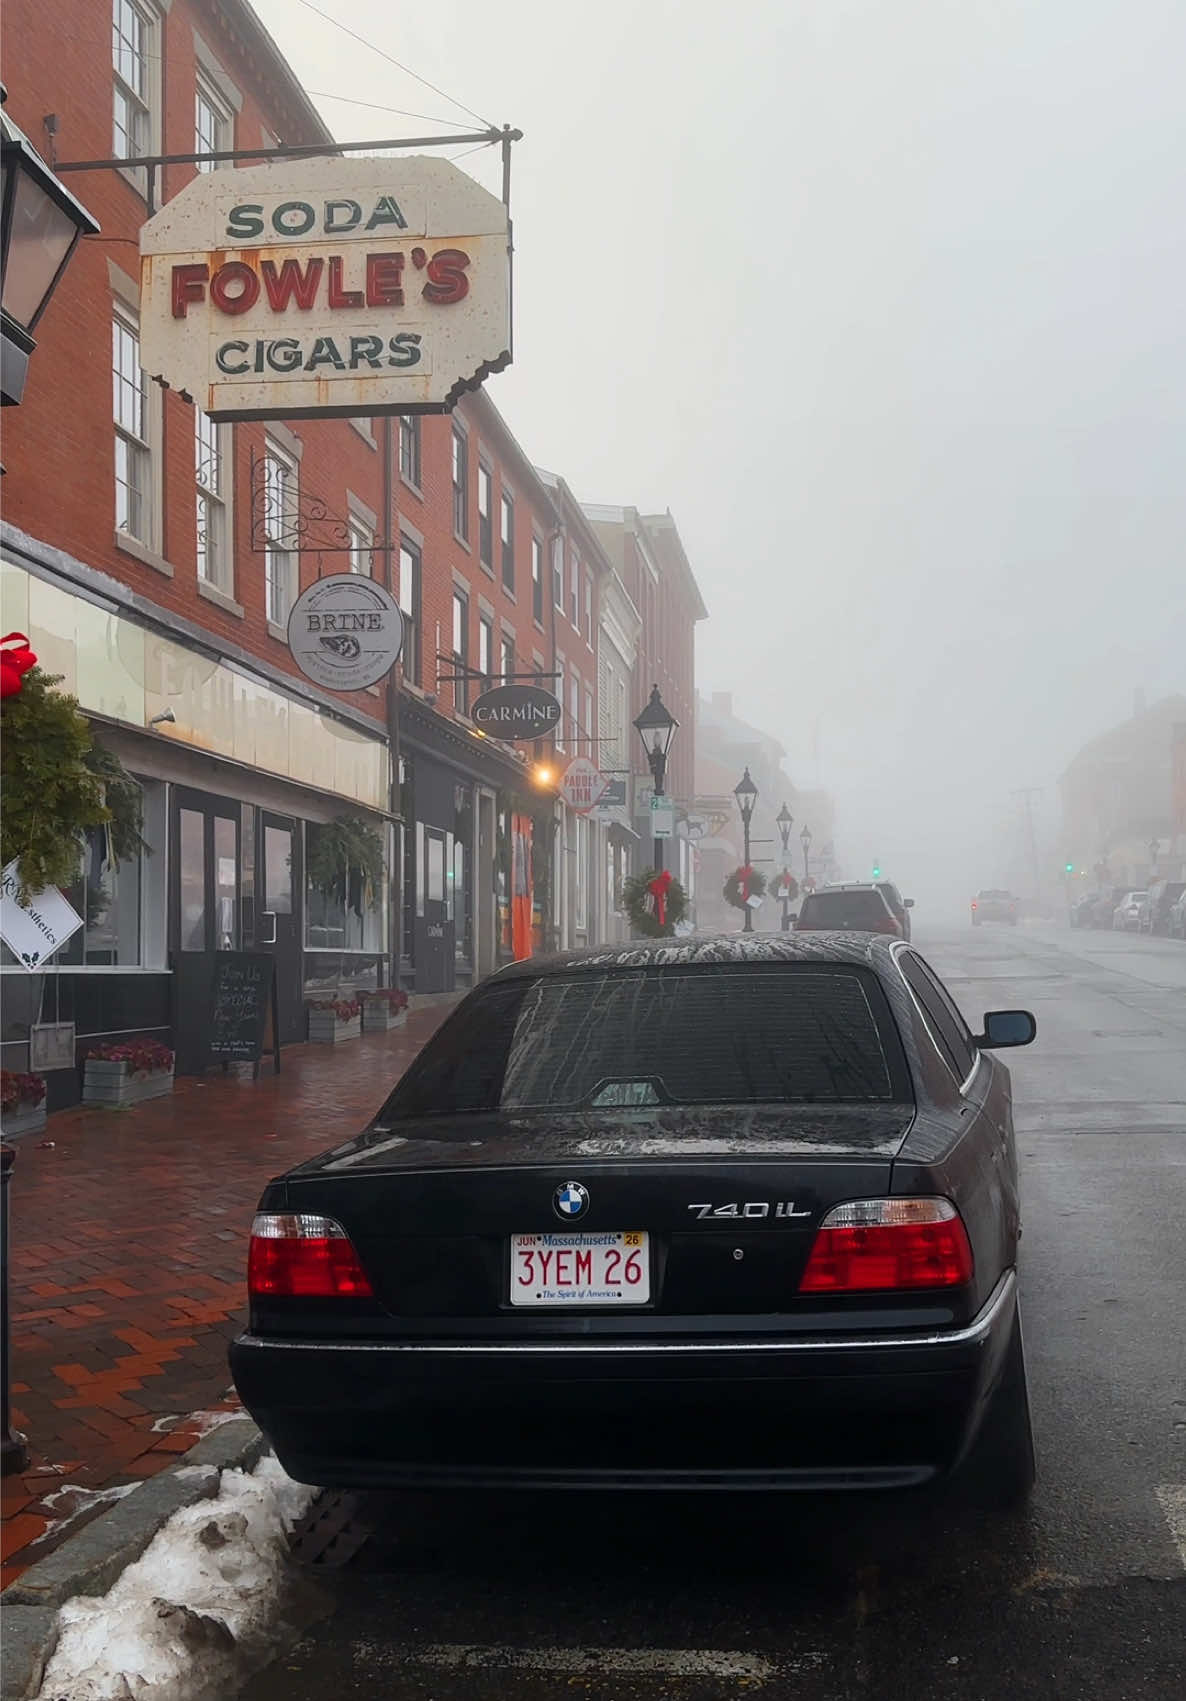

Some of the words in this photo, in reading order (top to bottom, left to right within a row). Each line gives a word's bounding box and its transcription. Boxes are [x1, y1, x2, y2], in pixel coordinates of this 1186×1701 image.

[226, 196, 408, 238] SODA
[171, 247, 471, 319] FOWLE'S
[215, 332, 422, 375] CIGARS
[306, 613, 382, 632] BRINE
[476, 702, 558, 721] CARMINE
[571, 788, 592, 801] INN
[517, 1236, 536, 1246] JUN
[542, 1233, 618, 1246] Massachusetts
[625, 1235, 640, 1245] 26
[518, 1250, 592, 1286] 3YEM
[604, 1249, 642, 1285] 26
[542, 1290, 556, 1298] The
[558, 1290, 577, 1300] Spirit
[586, 1290, 616, 1298] America
